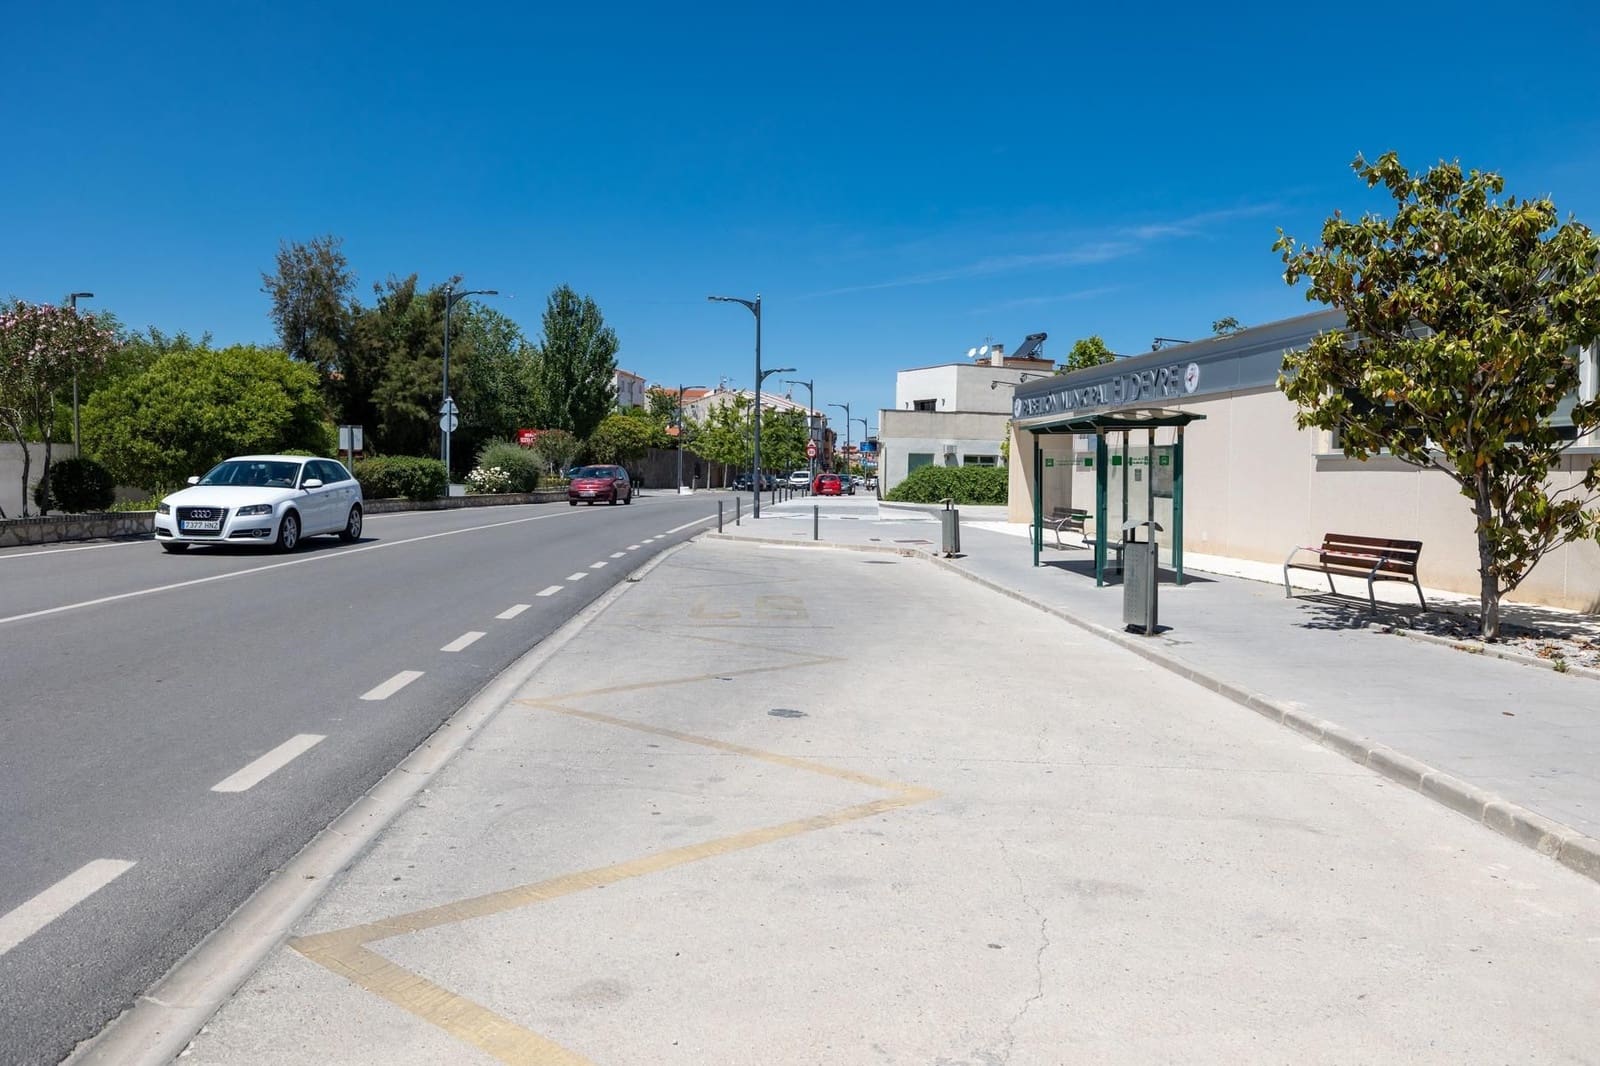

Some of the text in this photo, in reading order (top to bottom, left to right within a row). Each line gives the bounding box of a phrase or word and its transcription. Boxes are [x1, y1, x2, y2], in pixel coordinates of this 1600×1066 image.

[1023, 392, 1056, 416] PABELLÓN
[1061, 384, 1108, 409] MUNICIPAL
[1130, 366, 1180, 401] DEYRE
[185, 521, 203, 529] 7377
